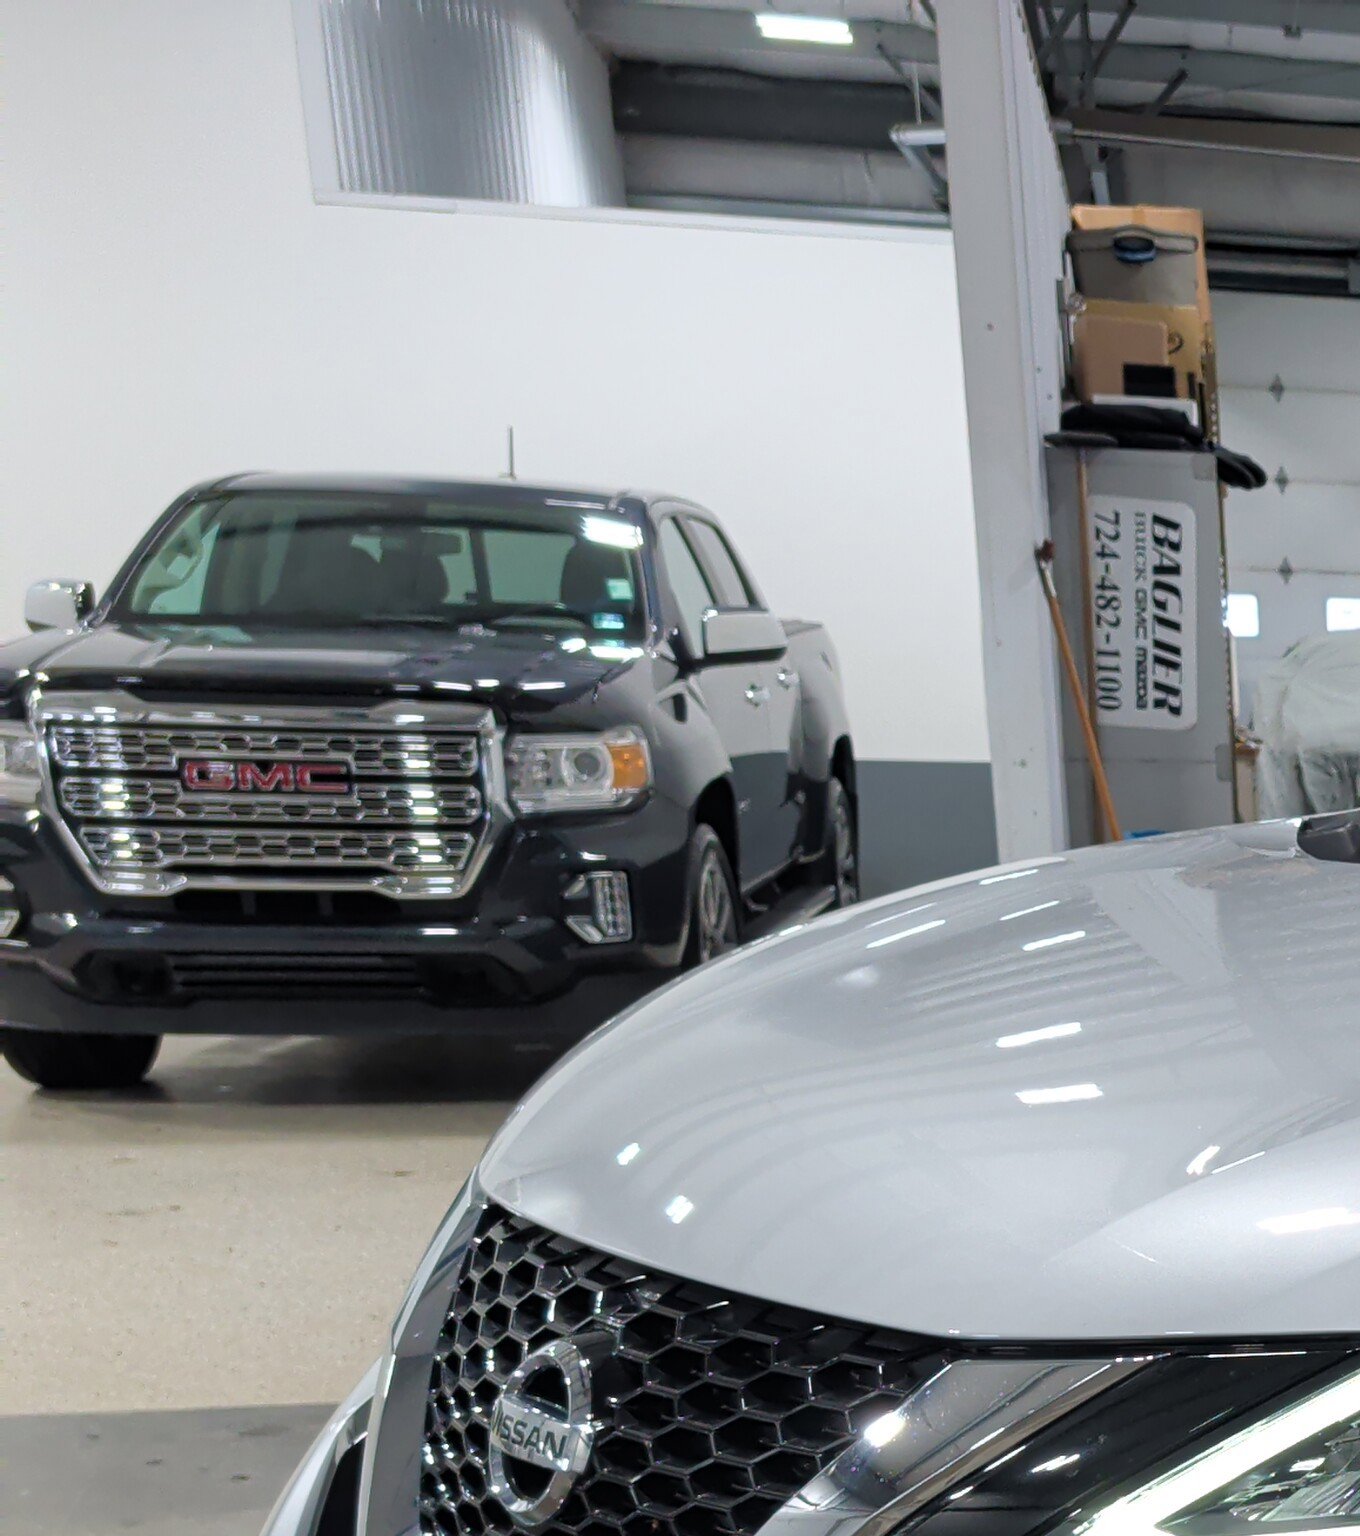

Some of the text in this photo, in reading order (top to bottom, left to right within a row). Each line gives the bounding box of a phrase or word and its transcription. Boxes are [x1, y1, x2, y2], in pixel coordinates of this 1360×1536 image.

[1134, 511, 1148, 582] BUICK
[1095, 509, 1122, 710] 724-482-1100
[1135, 588, 1148, 640] GMC
[1152, 513, 1183, 717] BAGLIER
[184, 760, 349, 793] GMC
